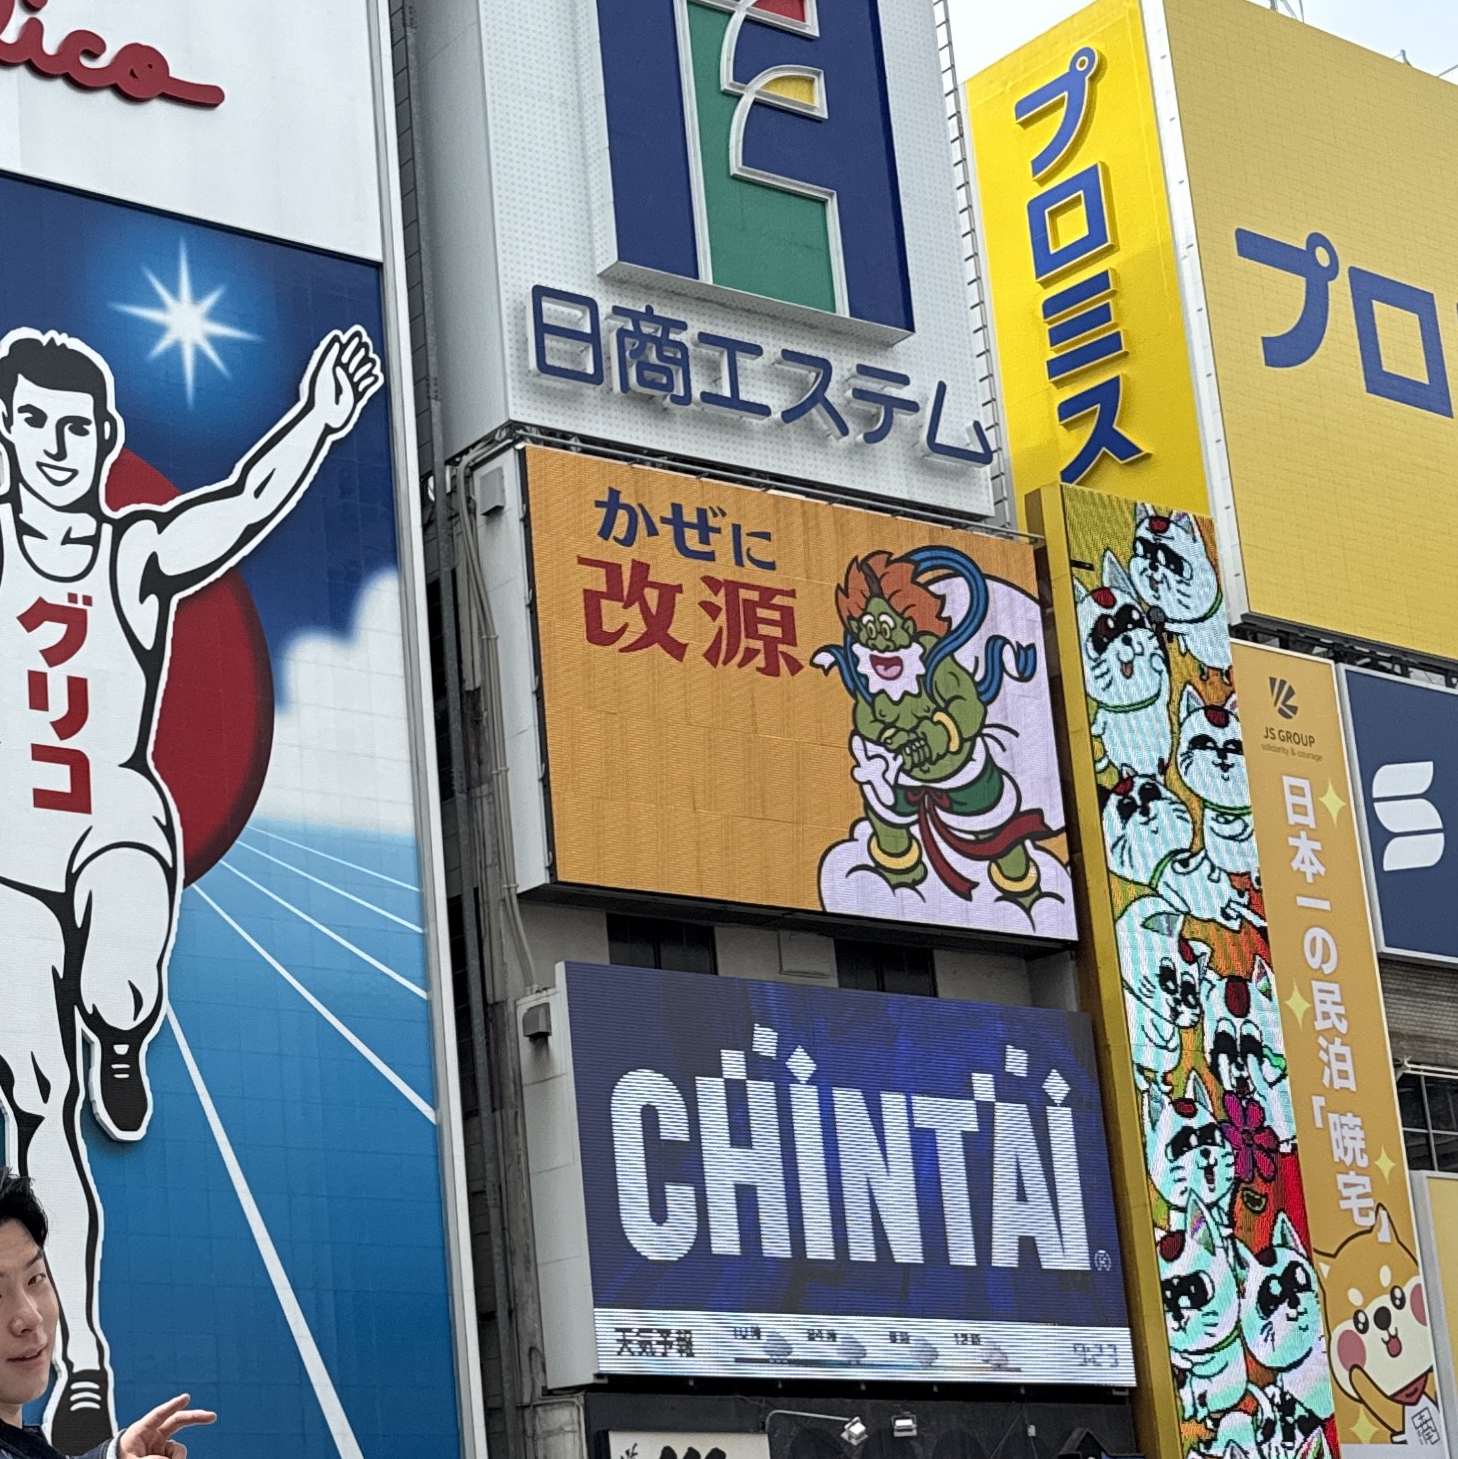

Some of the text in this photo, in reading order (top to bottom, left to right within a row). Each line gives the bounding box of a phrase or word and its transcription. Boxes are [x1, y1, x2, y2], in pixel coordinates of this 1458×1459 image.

[1015, 46, 1146, 485] プロミス
[1235, 227, 1458, 419] プロ
[530, 284, 993, 466] 日商エステム
[594, 486, 777, 571] かぜに
[577, 555, 804, 677] 改源
[16, 591, 93, 815] グリコ
[1263, 726, 1316, 748] JS GROUP
[614, 1327, 694, 1358] 天気予報
